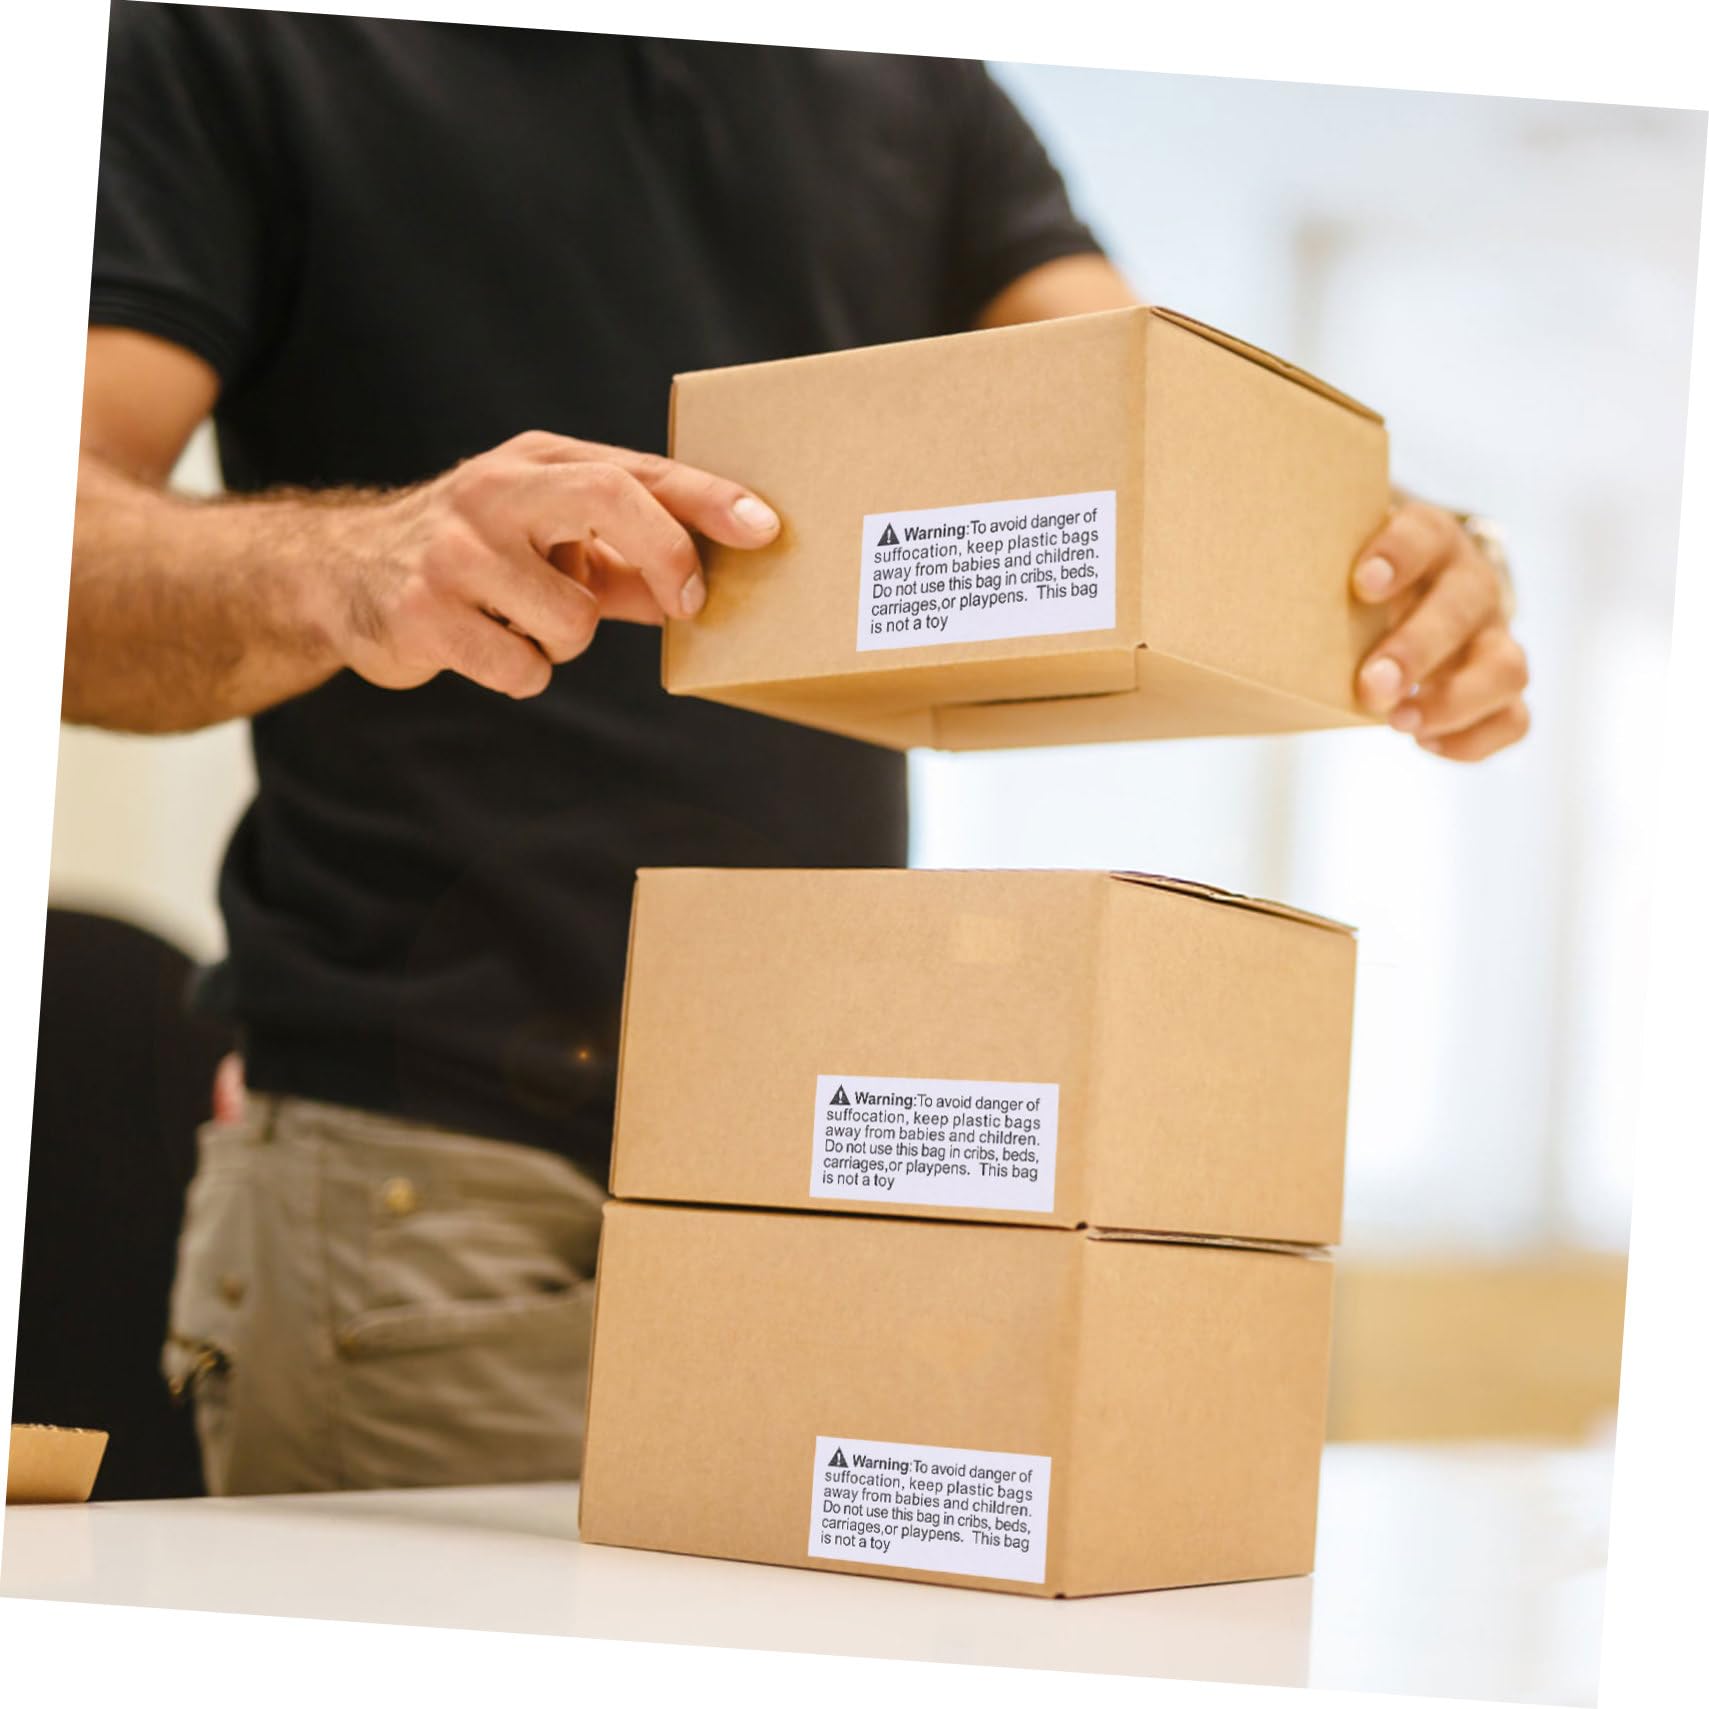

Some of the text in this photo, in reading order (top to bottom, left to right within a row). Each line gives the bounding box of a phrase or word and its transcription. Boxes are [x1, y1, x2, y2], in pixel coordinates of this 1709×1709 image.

[990, 516, 1027, 532] avoid
[1031, 512, 1080, 531] danger
[1083, 508, 1097, 522] of
[874, 529, 1098, 563] suffocation, keep plastic bags
[873, 547, 1099, 583] away from babies and children.
[873, 563, 1098, 598] Do not use this bag in cribs, beds,
[960, 588, 1027, 611] playpens.
[1037, 584, 1067, 600] This
[1071, 581, 1098, 598] bag
[871, 614, 949, 634] is not a toy
[936, 1095, 971, 1109] avoid
[975, 1096, 1023, 1113] danger
[1026, 1098, 1040, 1111] of
[826, 1108, 1040, 1132] suffocation, keep plastic bags
[825, 1125, 1040, 1146] away from babies and children.
[825, 1139, 1039, 1164] Do not use this bag in cribs, beds,
[822, 1170, 894, 1191] is not a toy
[906, 1159, 970, 1176] playpens.
[979, 1162, 1008, 1177] This
[1012, 1164, 1038, 1181] bag
[931, 1462, 965, 1477] avoid
[969, 1465, 1015, 1484] danger
[1019, 1470, 1032, 1483] of
[825, 1470, 1032, 1503] suffocation, keep plastic bags
[824, 1486, 1032, 1517] away from babies and children.
[823, 1500, 1031, 1534] Do not use this bag in cribs, beds,
[821, 1531, 890, 1553] is not a toy
[901, 1524, 963, 1542] playpens.
[972, 1531, 1000, 1546] This
[1004, 1534, 1030, 1553] bag
